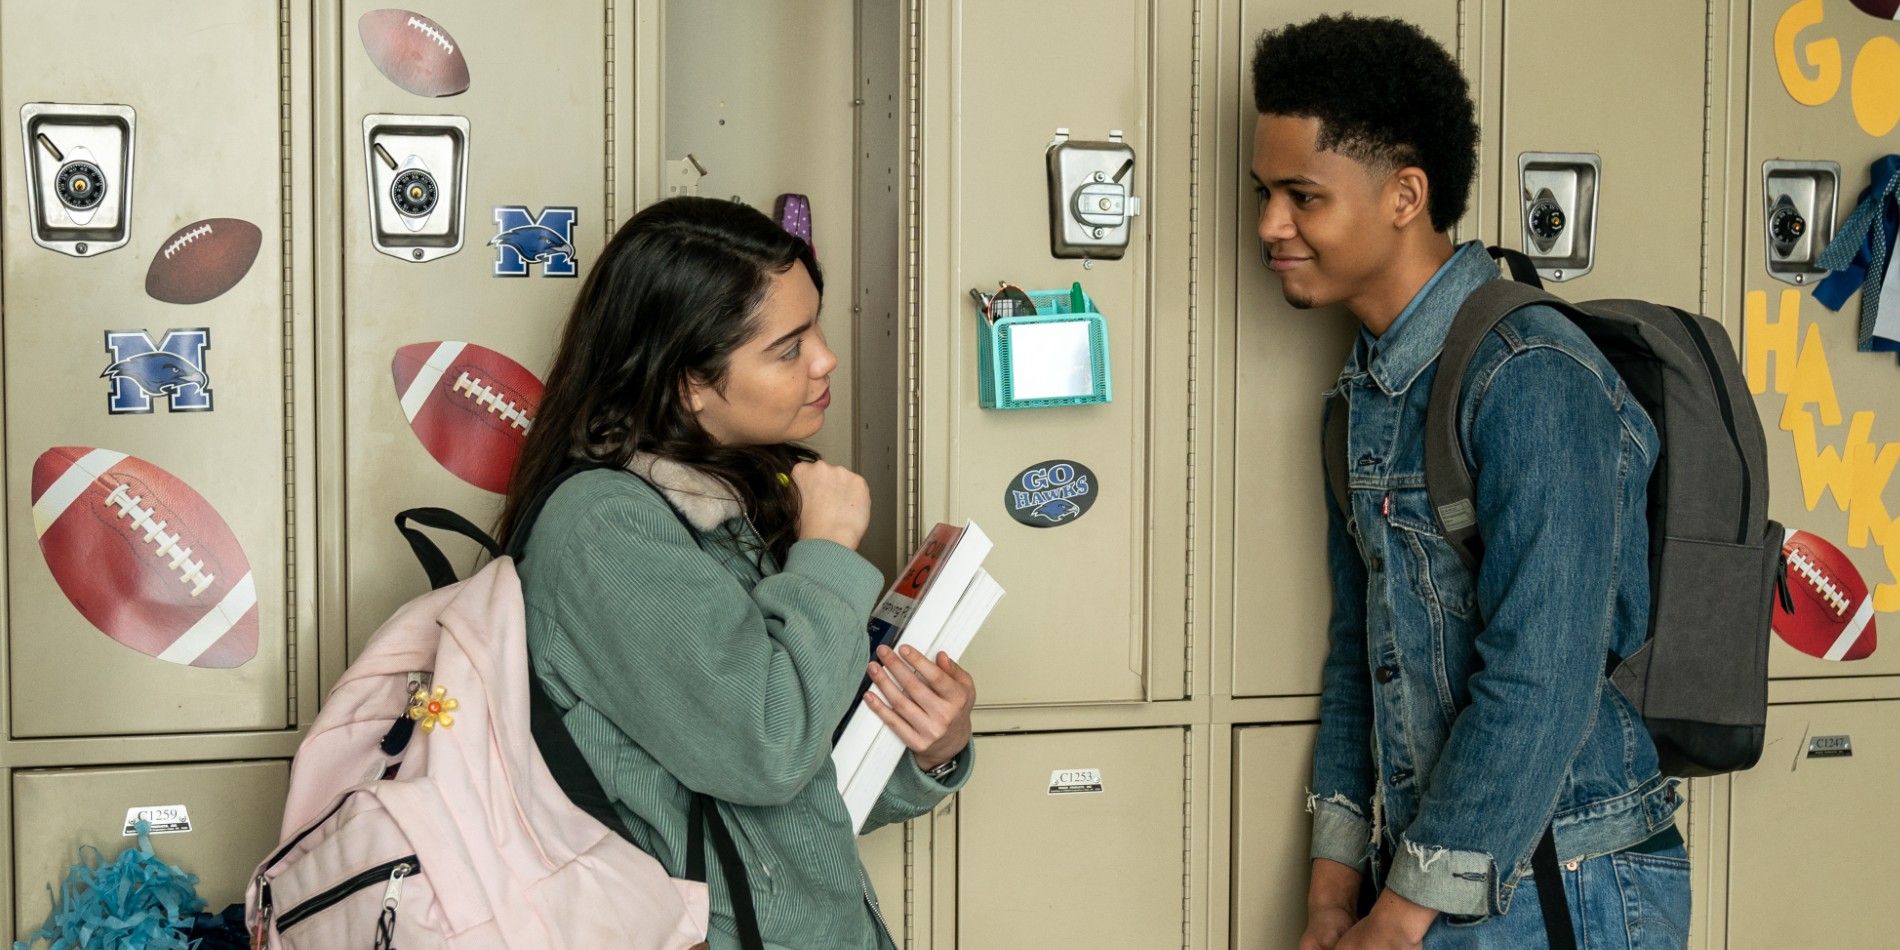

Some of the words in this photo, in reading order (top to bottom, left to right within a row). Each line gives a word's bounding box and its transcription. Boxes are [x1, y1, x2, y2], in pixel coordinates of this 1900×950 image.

[1773, 0, 1900, 137] GO
[1022, 463, 1074, 491] GO
[1012, 475, 1089, 510] HAWKS
[1816, 737, 1845, 748] C1247
[1059, 771, 1093, 783] C1253
[137, 809, 178, 821] C1259
